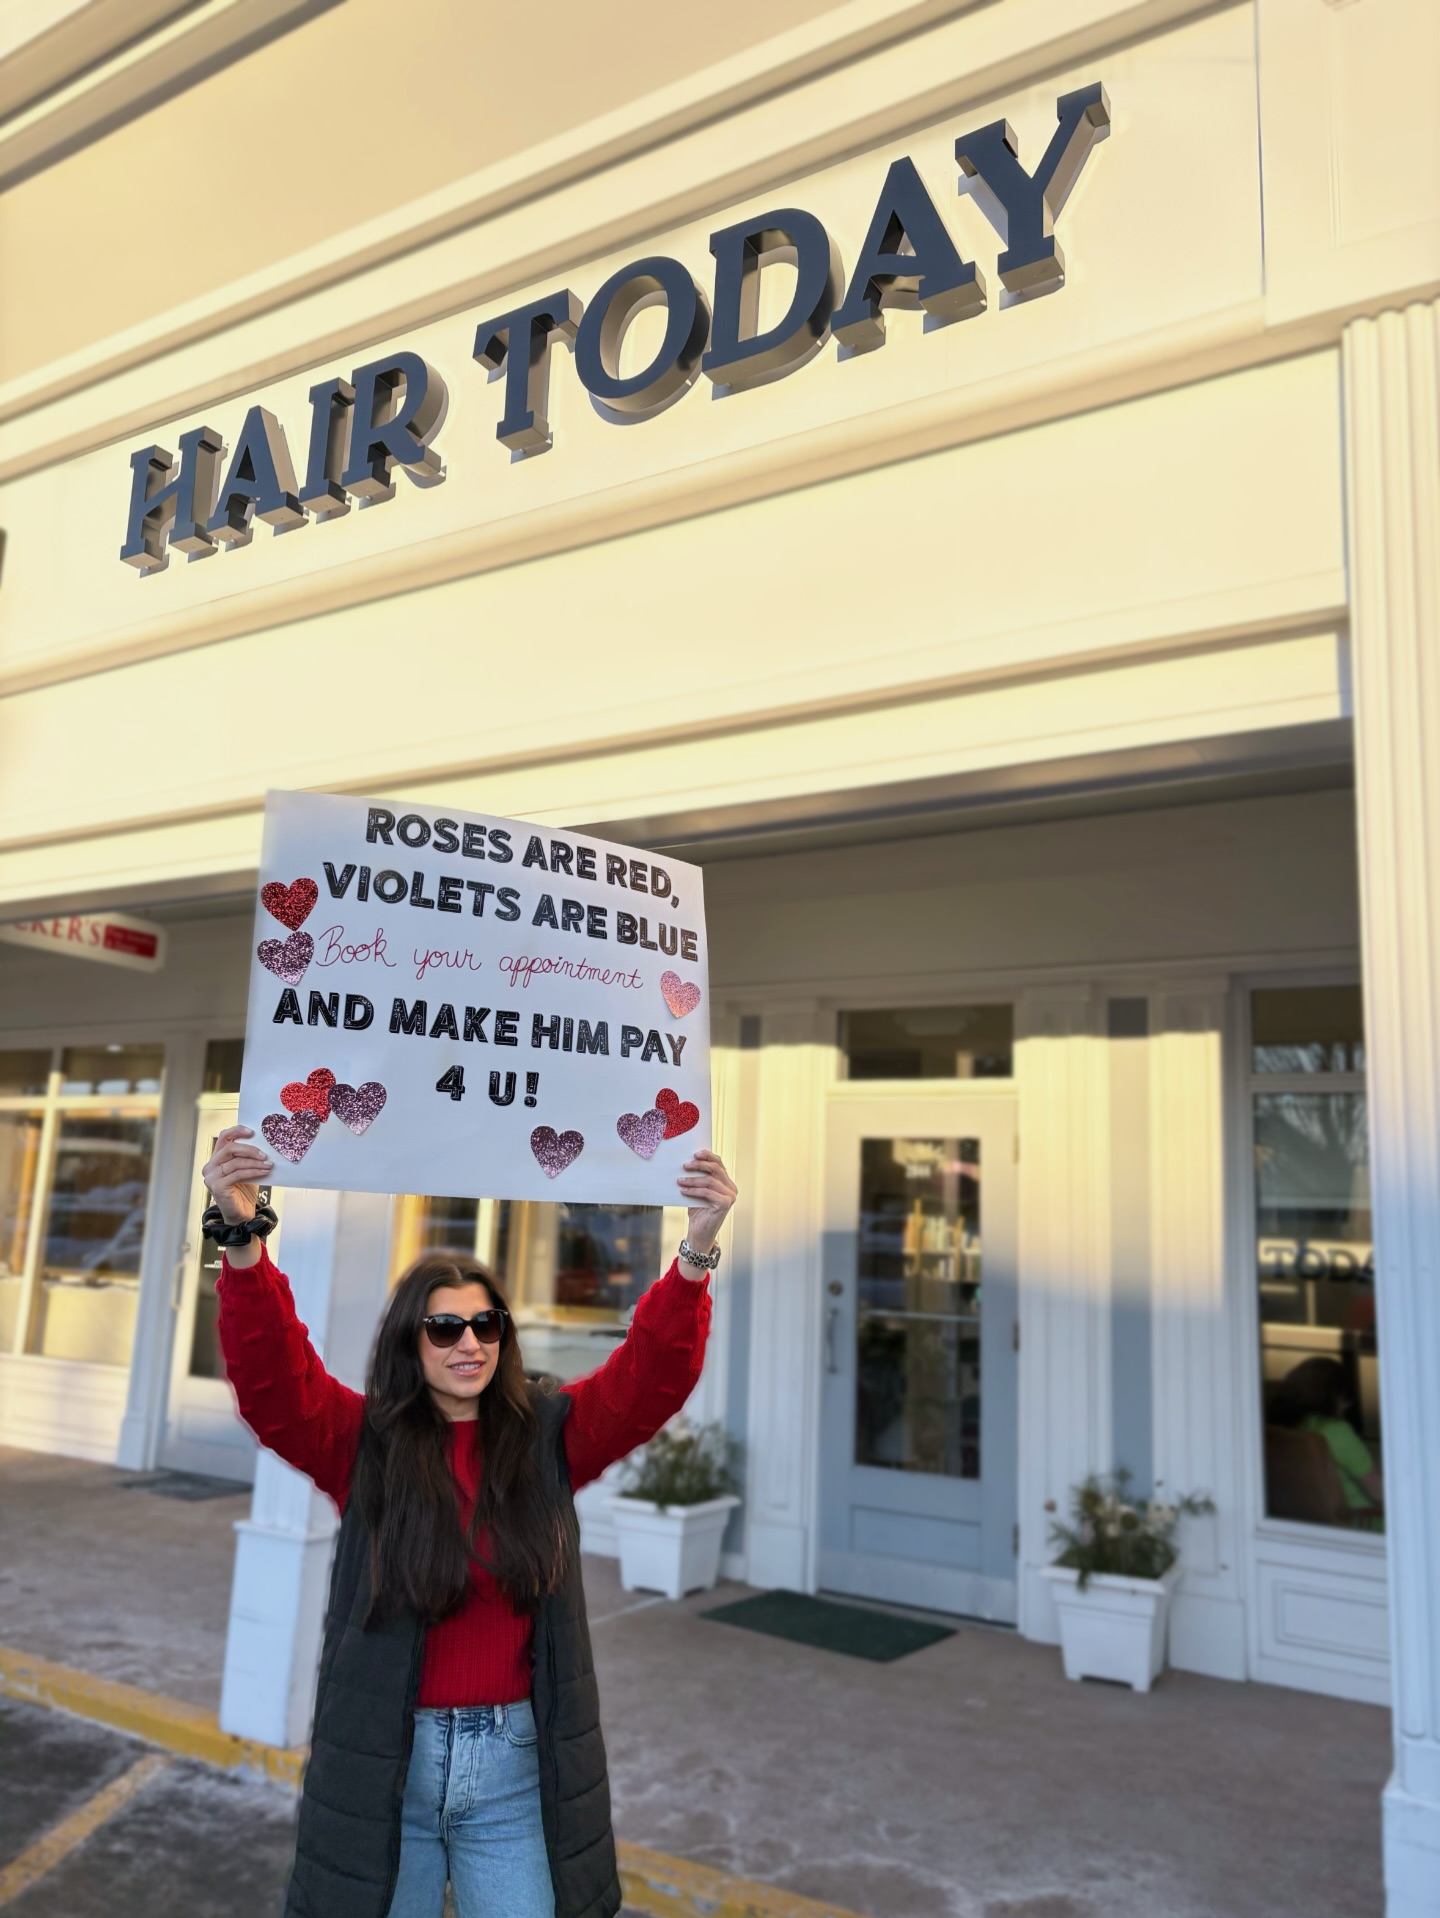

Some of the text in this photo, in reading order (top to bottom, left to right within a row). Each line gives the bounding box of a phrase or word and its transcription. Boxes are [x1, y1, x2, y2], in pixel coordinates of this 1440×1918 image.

[120, 82, 1110, 570] HAIR TODAY
[365, 807, 681, 910] ROSES ARE RED,
[315, 925, 644, 989] Book your appointment
[322, 861, 699, 963] VIOLETS ARE BLUE
[272, 987, 688, 1067] AND MAKE HIM PAY
[435, 1064, 540, 1108] 4 U!
